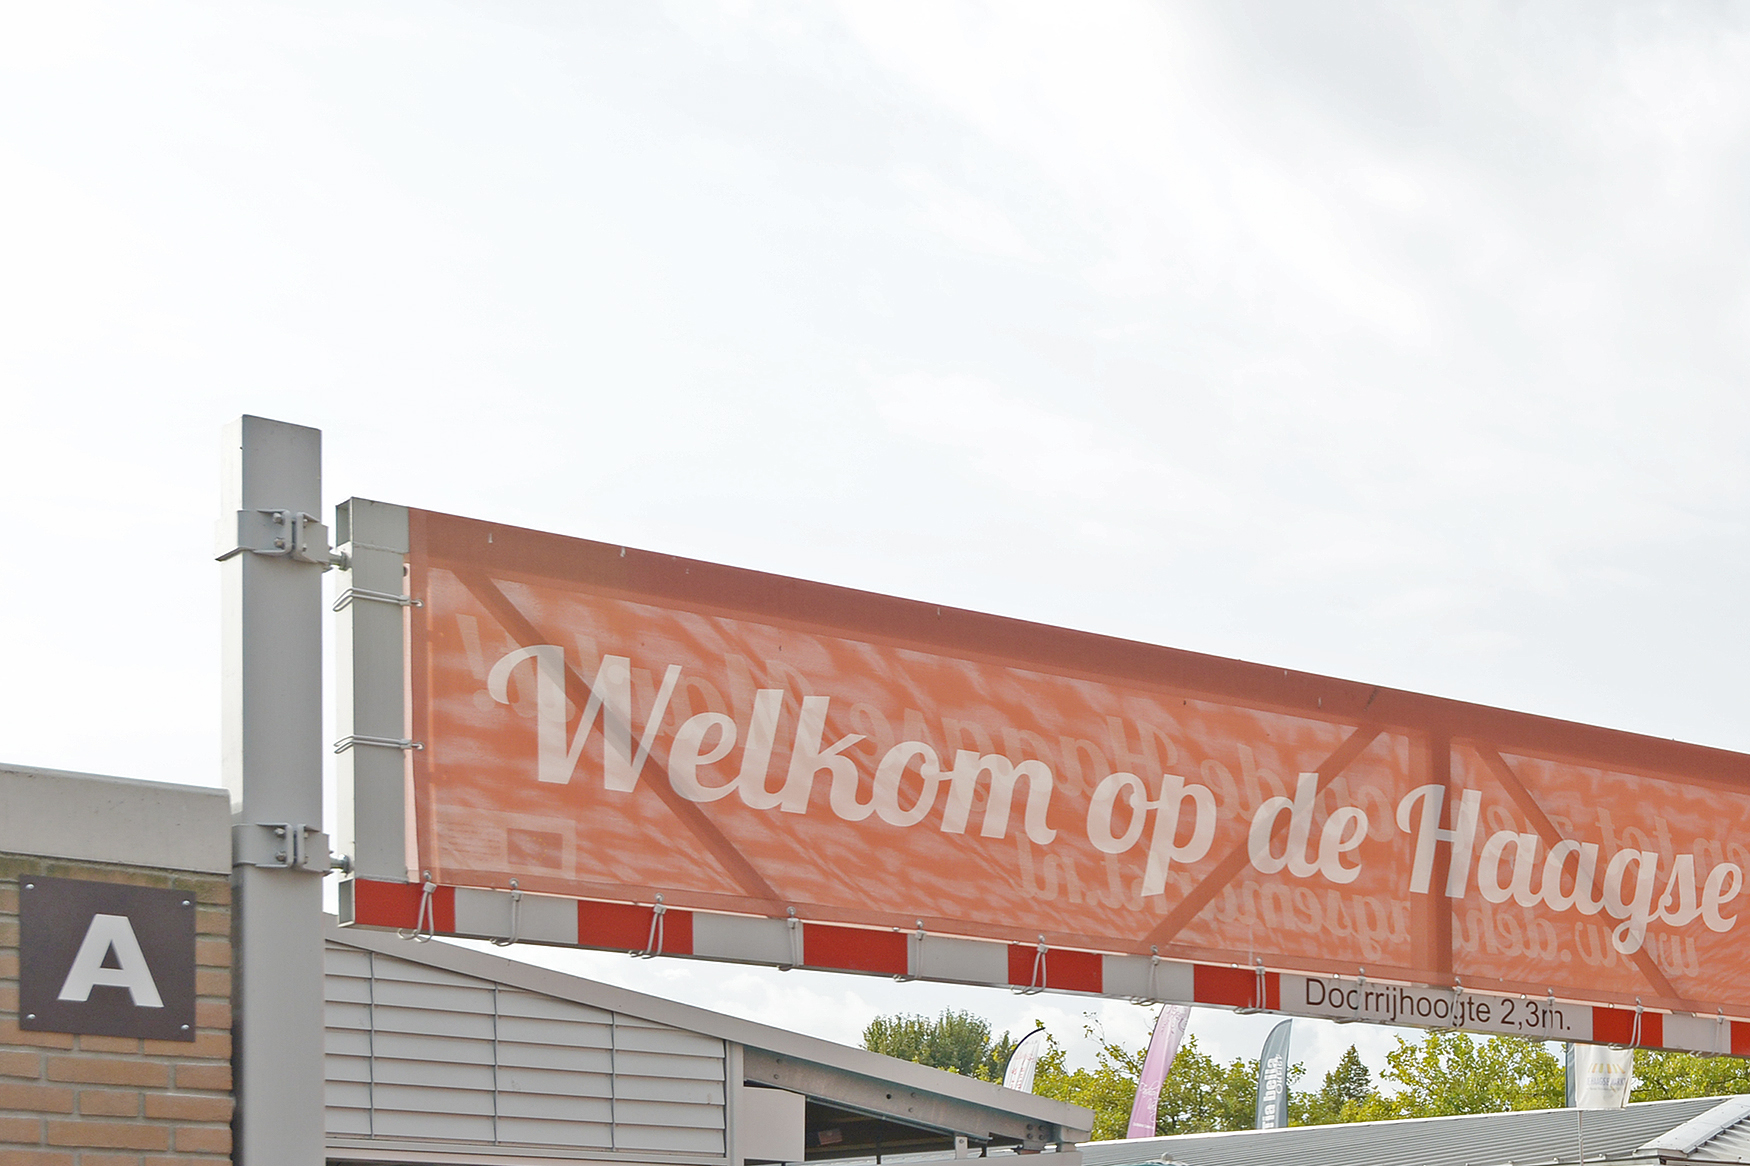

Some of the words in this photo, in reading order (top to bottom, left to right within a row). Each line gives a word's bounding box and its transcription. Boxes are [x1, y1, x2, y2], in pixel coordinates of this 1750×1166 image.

[487, 644, 1058, 846] Welkom
[1086, 772, 1218, 897] op
[1247, 772, 1369, 885] de
[1395, 783, 1743, 955] Haagse
[58, 913, 164, 1008] A
